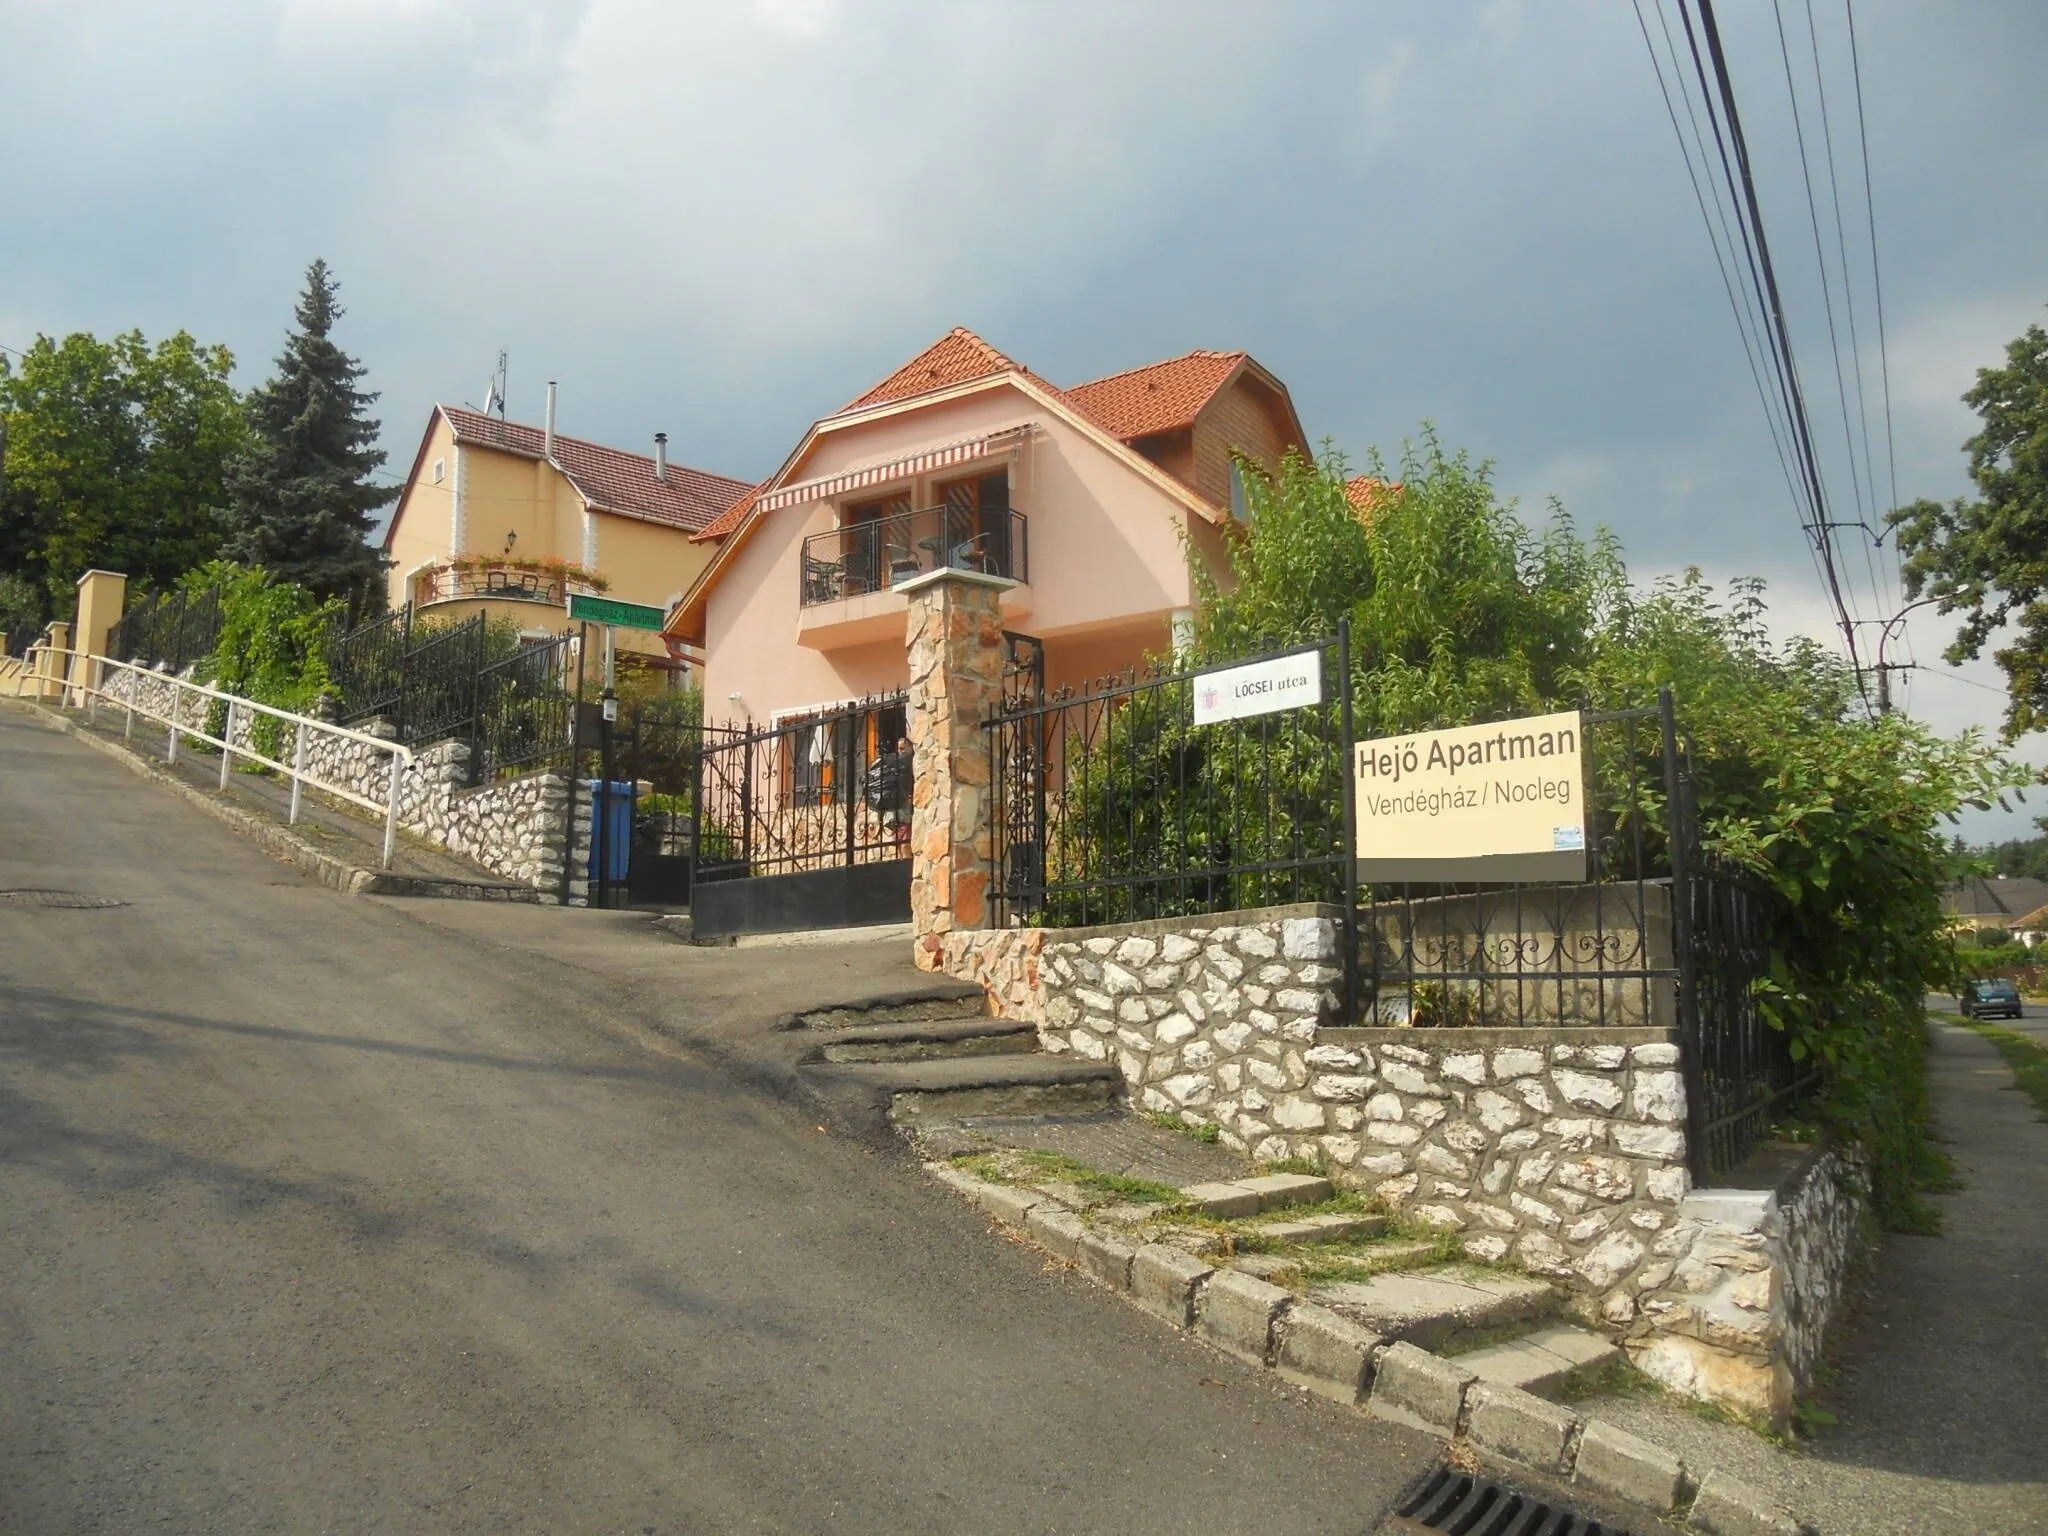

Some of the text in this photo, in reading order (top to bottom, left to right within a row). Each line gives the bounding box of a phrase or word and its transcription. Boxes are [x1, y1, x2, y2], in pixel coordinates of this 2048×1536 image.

[1278, 675, 1308, 690] utca
[1360, 729, 1575, 783] Hejő Apartman
[1367, 785, 1477, 816] Vendégház
[1495, 776, 1570, 804] Nocleg
